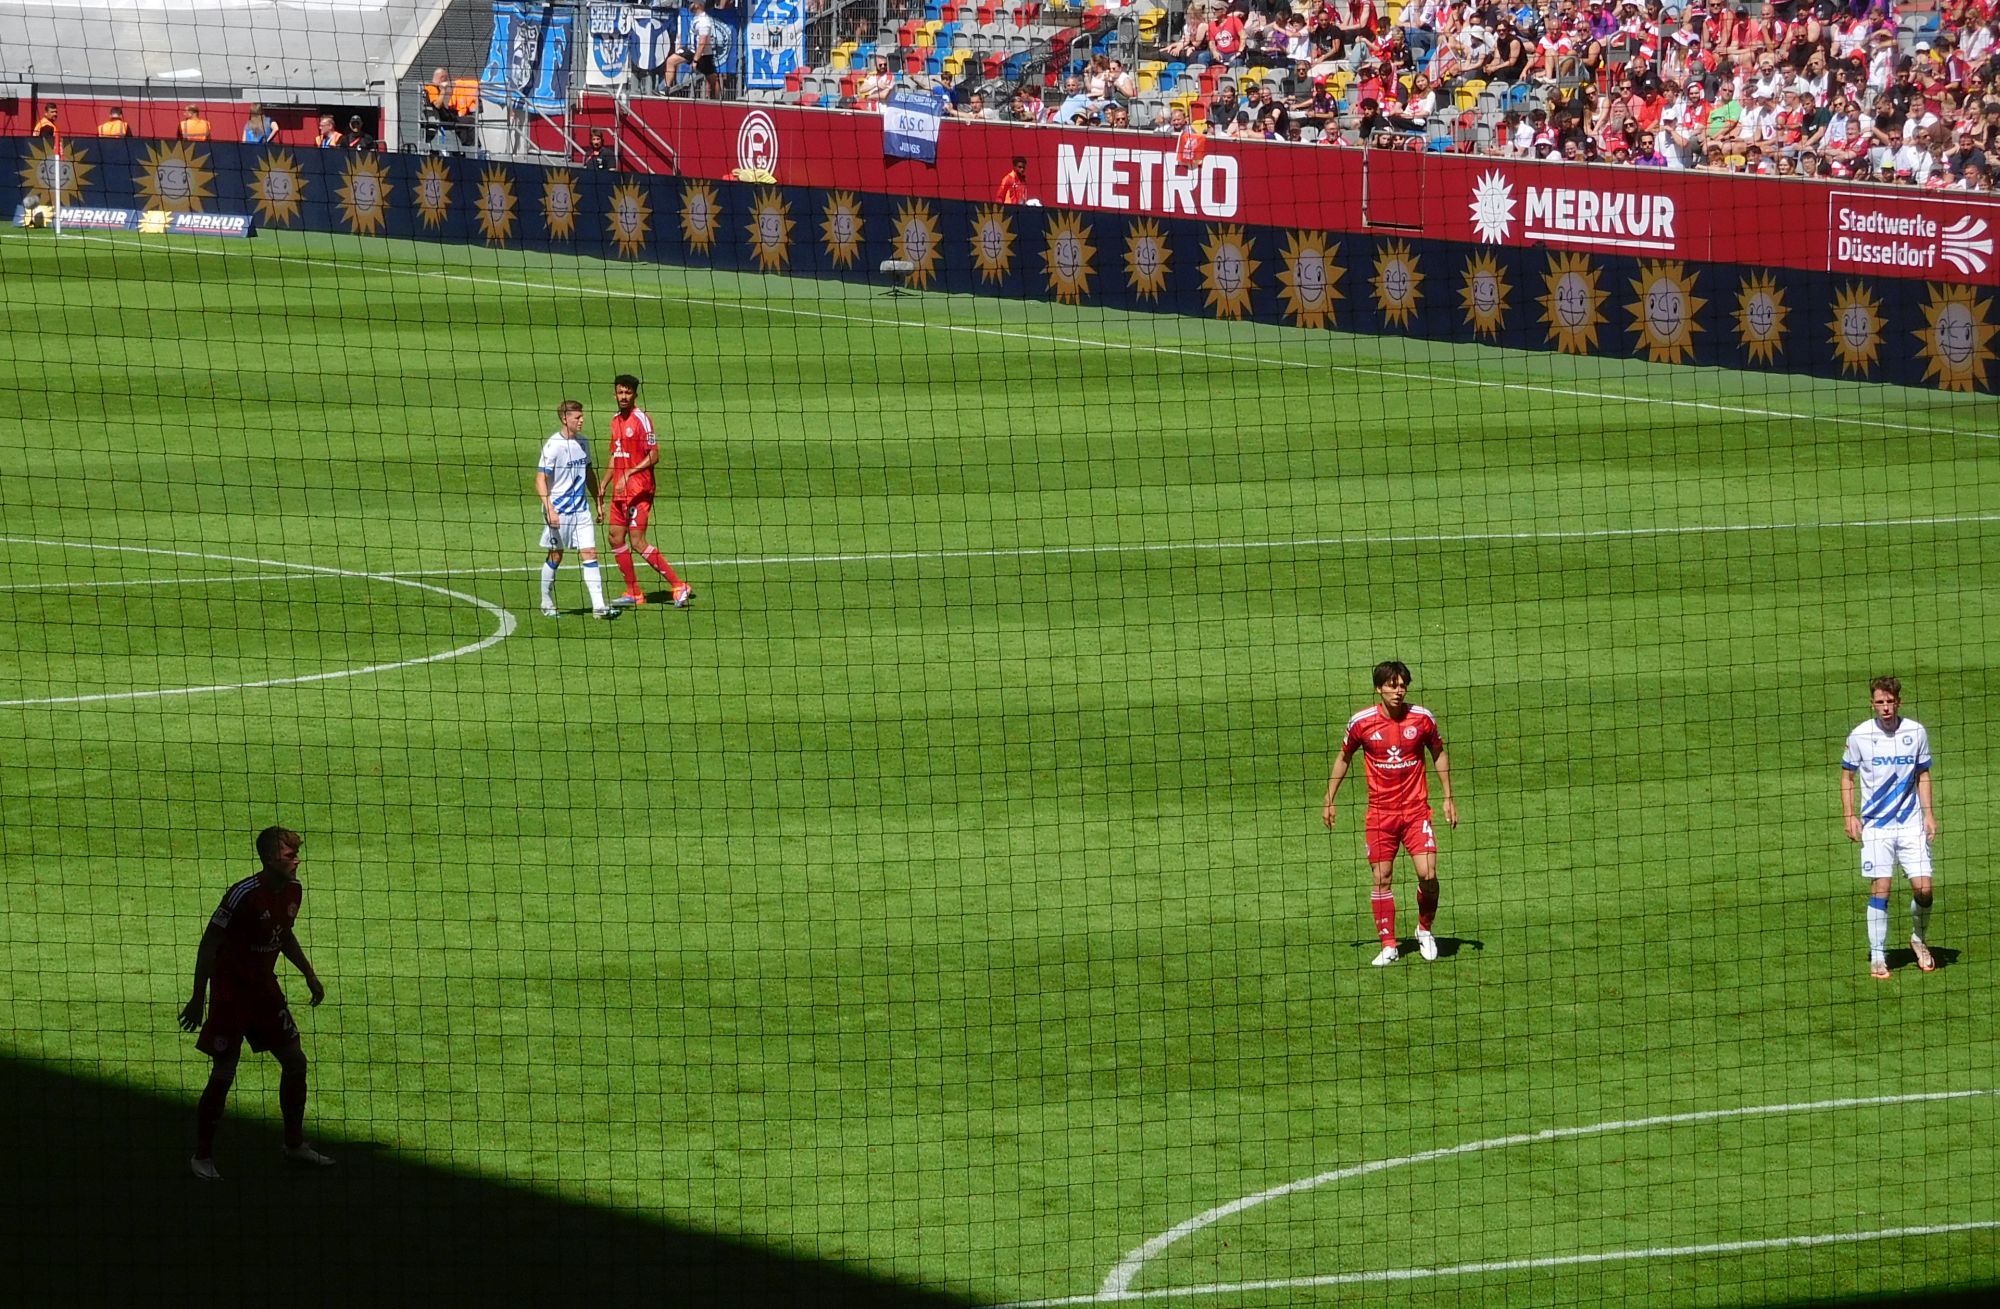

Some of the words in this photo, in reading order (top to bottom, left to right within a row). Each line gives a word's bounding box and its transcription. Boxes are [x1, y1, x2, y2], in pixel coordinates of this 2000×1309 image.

[591, 20, 614, 33] 2009
[1057, 144, 1238, 217] METRO
[59, 208, 128, 224] MERKUR
[1525, 187, 1675, 238] MERKUR
[176, 214, 245, 230] MERKUR
[1839, 208, 1937, 238] Stadtwerke
[1838, 237, 1936, 268] Düsseldorf
[567, 457, 590, 466] SWE
[629, 506, 638, 519] 9
[1872, 755, 1914, 766] SWEG
[1422, 820, 1433, 838] 4
